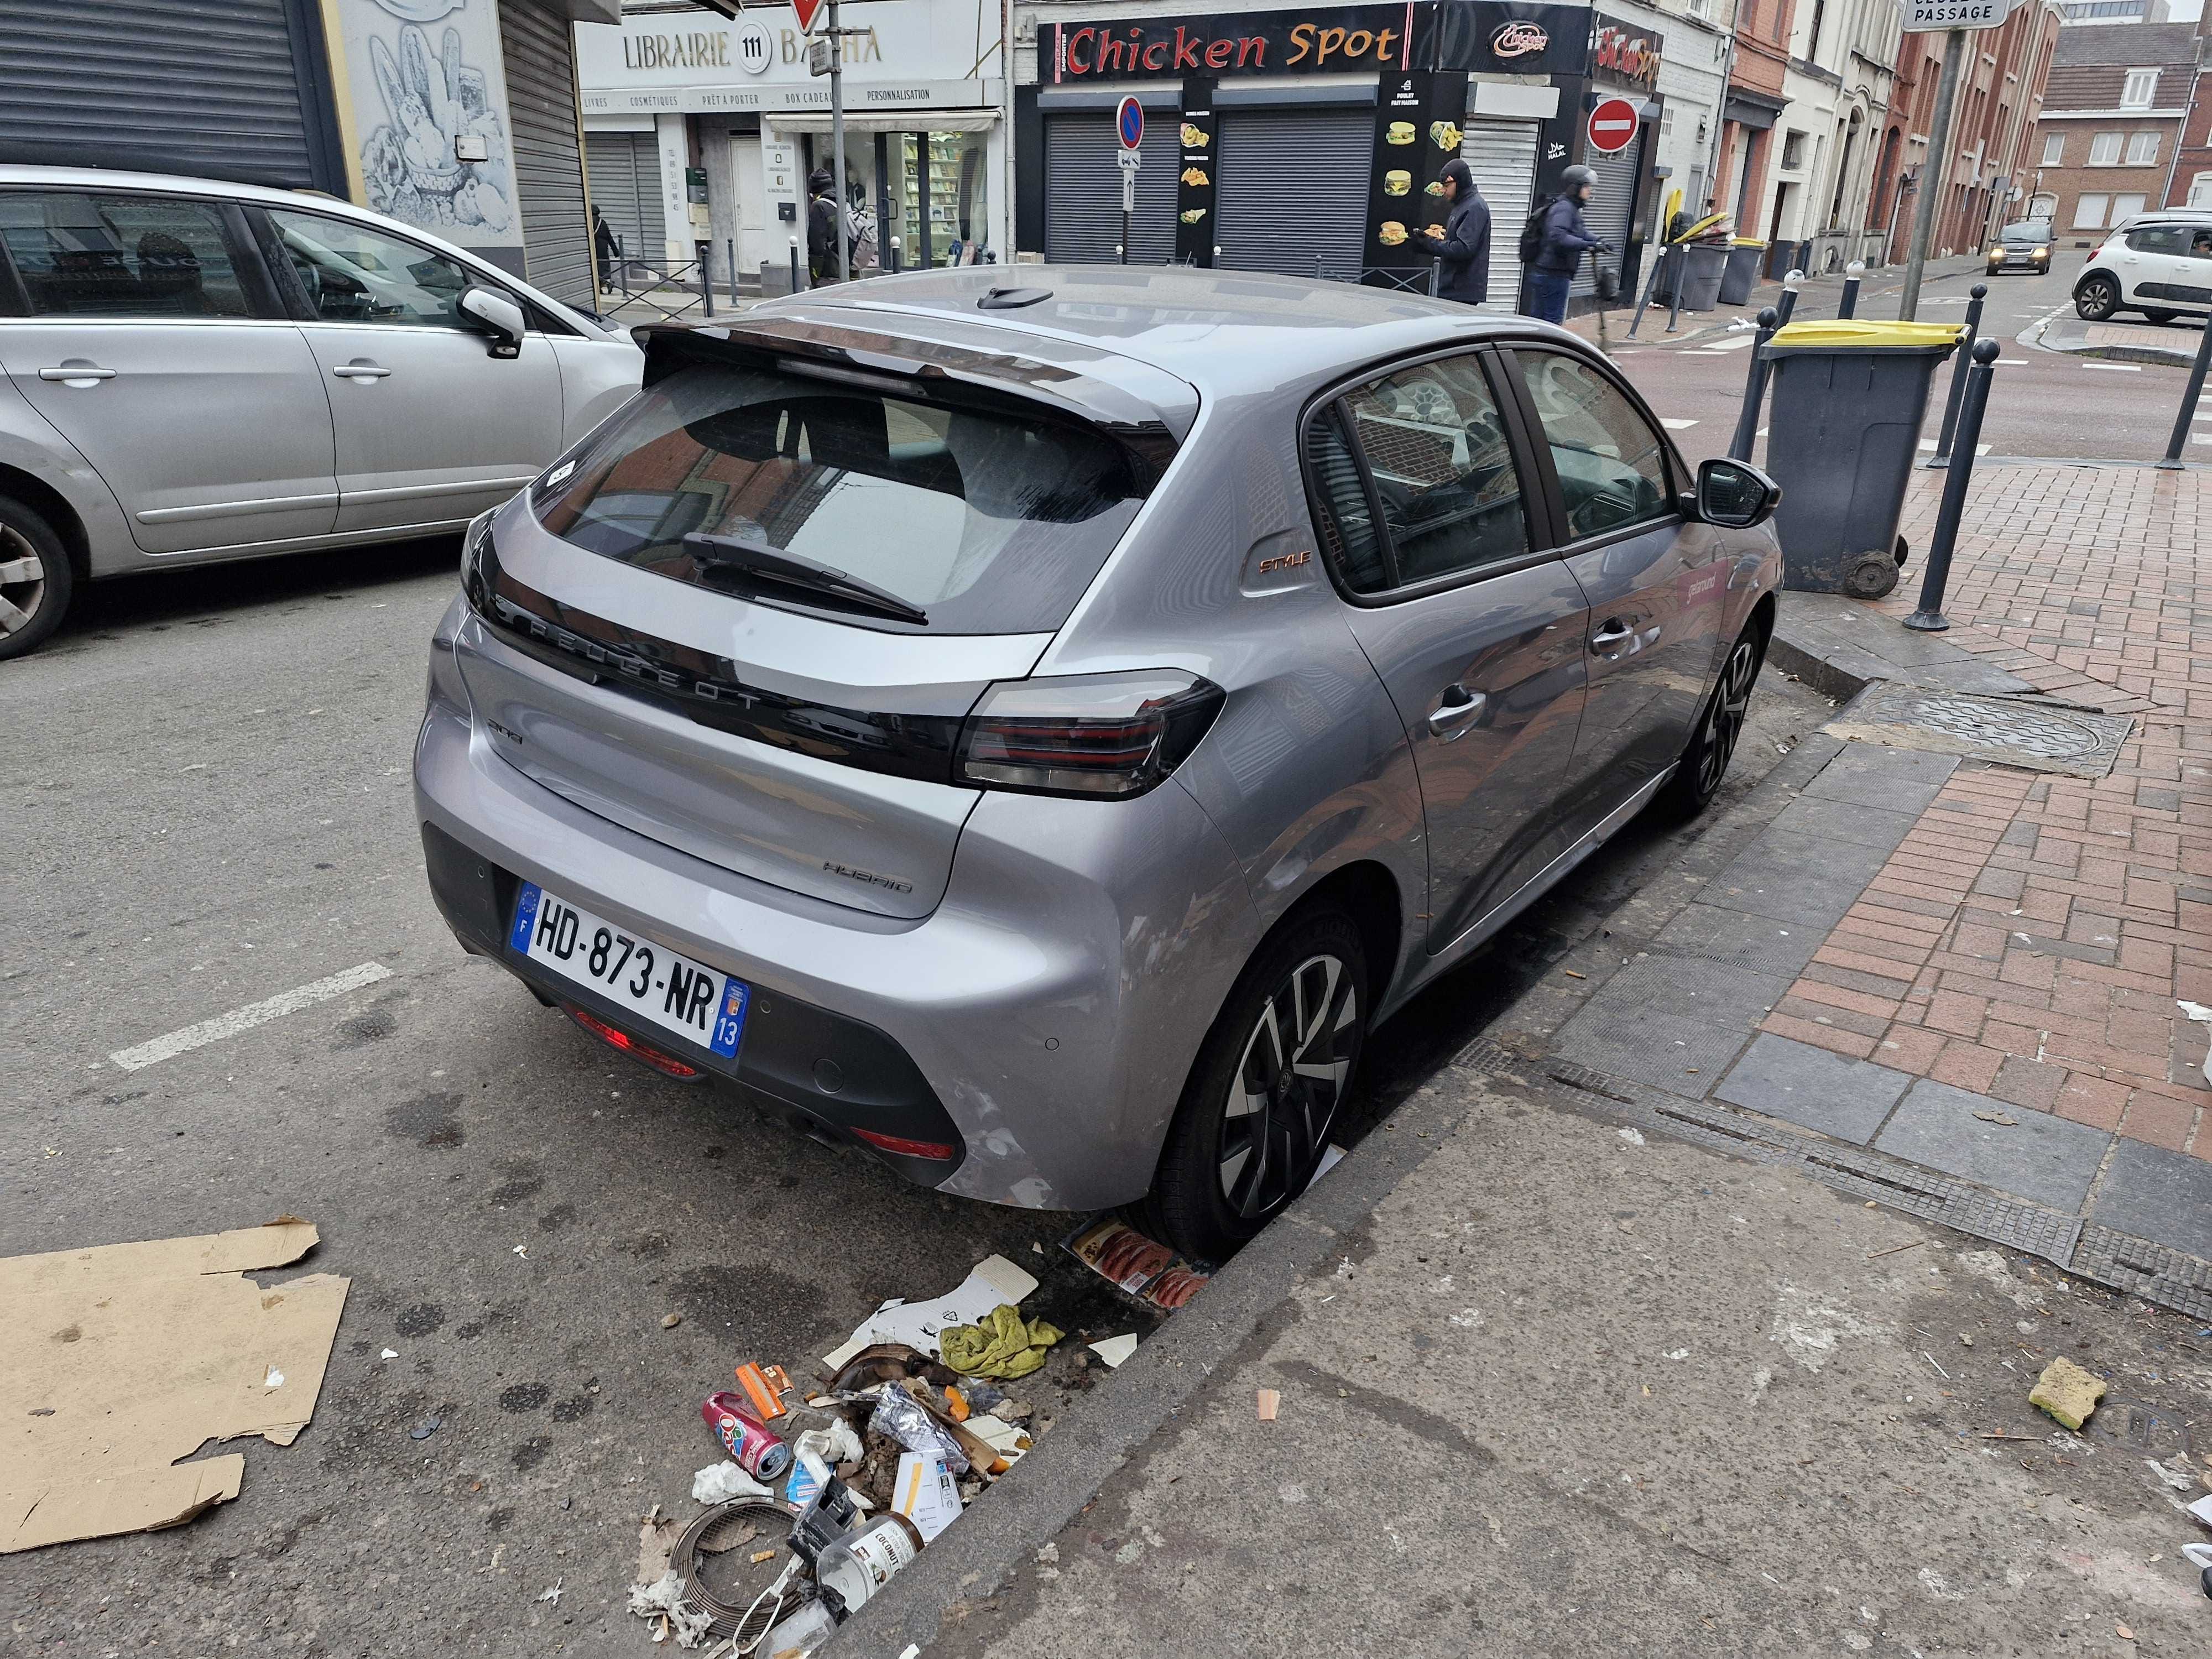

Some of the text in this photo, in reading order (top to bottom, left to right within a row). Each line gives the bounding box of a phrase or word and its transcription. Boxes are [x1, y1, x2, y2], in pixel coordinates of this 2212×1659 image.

[1915, 6, 1992, 22] PASSAGE
[624, 32, 731, 69] LIBRAIRIE
[743, 36, 762, 58] 111
[1068, 23, 1400, 74] Chicken Spot
[585, 98, 607, 107] LIVRES
[731, 94, 759, 105] PORTER
[785, 93, 800, 103] BOX
[867, 89, 930, 101] PERSONNALISATION
[1548, 150, 1566, 160] HALAL
[1259, 551, 1311, 573] STYLE
[1687, 571, 1717, 605] getaround
[530, 620, 760, 710] PEUGEOT
[823, 860, 912, 894] HYBRID
[520, 919, 527, 932] F
[536, 899, 714, 1031] HD-873-NR
[718, 1017, 738, 1046] 13
[875, 1533, 899, 1566] COCONUT
